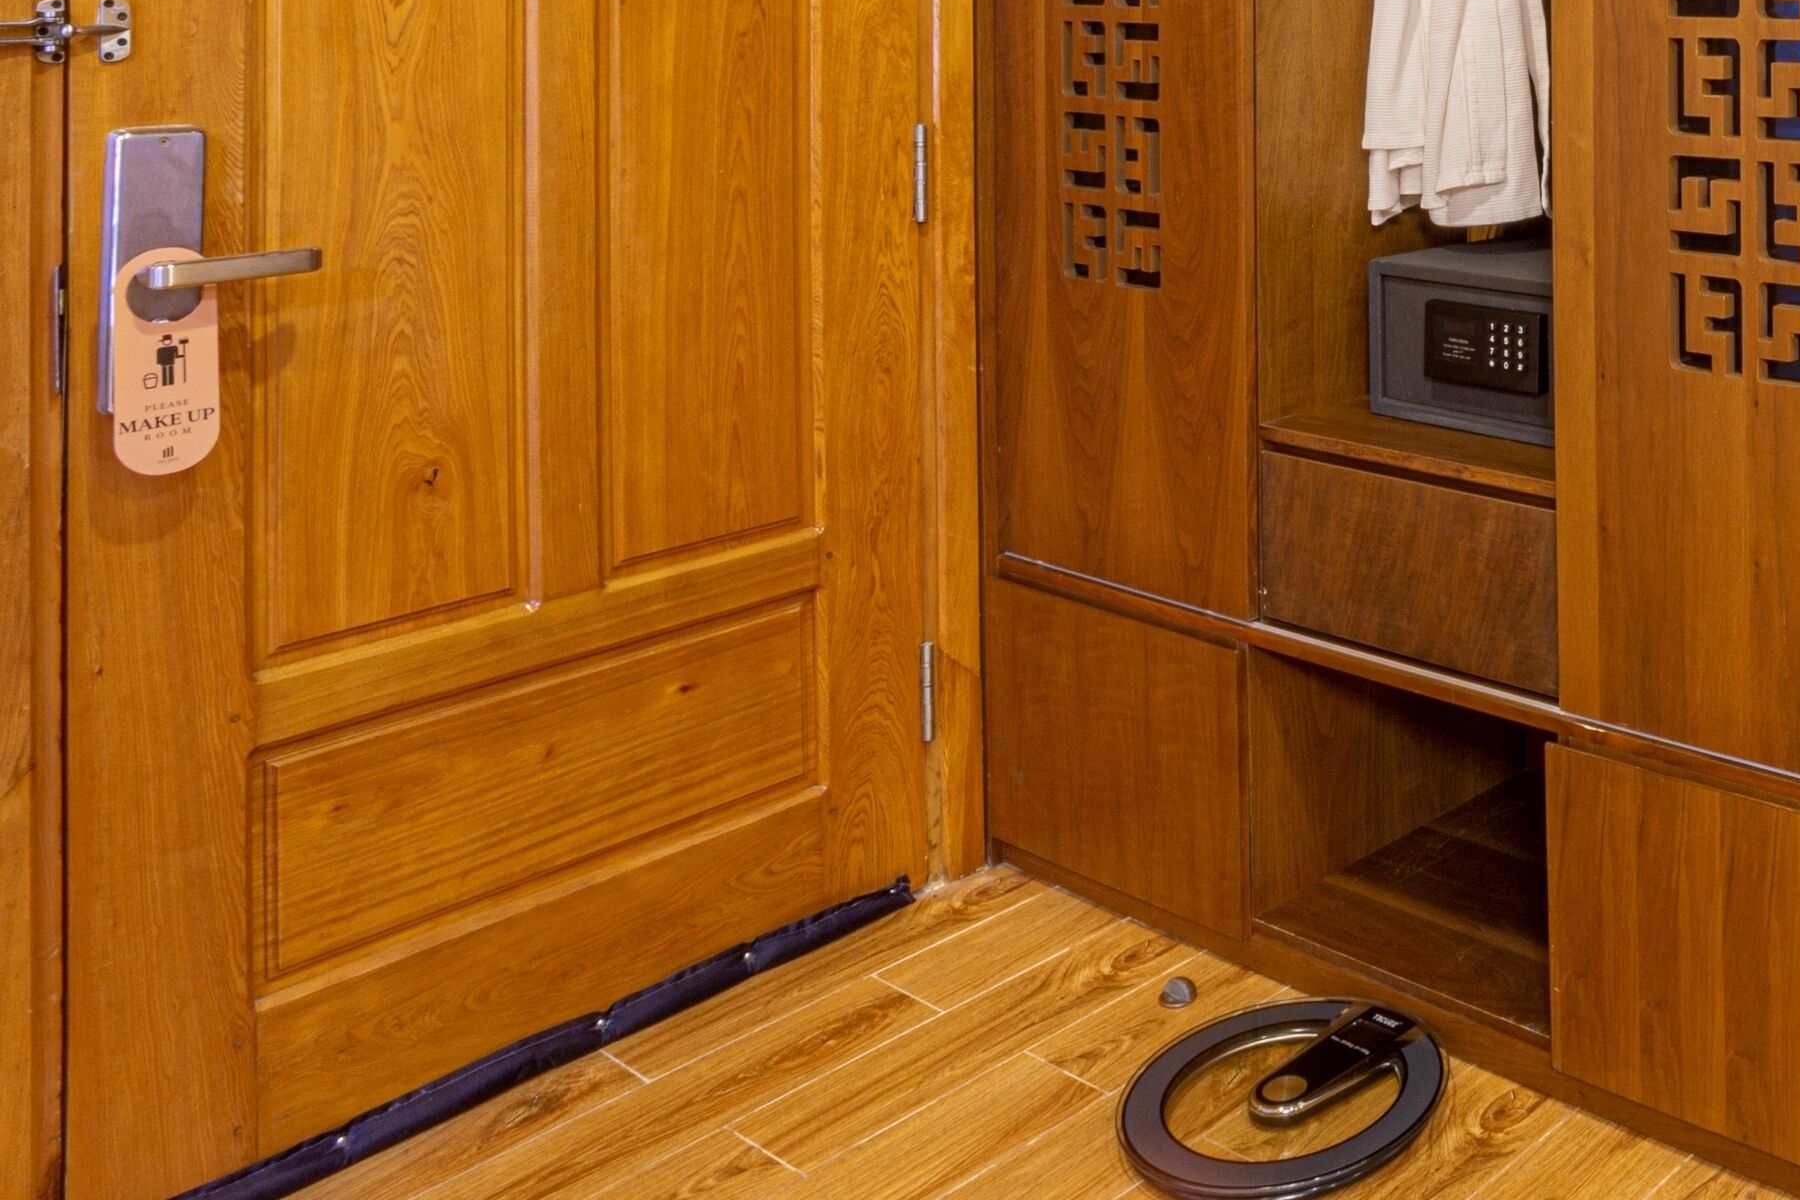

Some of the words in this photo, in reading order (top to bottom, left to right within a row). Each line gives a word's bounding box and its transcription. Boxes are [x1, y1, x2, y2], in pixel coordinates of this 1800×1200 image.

[1489, 322, 1495, 331] 1
[1503, 324, 1509, 333] 2
[1518, 326, 1523, 334] 3
[1489, 335, 1495, 343] 4
[1503, 336, 1509, 345] 5
[1517, 338, 1523, 347] 6
[1489, 347, 1495, 355] 7
[1503, 349, 1509, 358] 8
[1517, 351, 1523, 360] 9
[1503, 361, 1509, 370] 0
[144, 398, 190, 412] PLEASE
[118, 412, 183, 435] MAKE
[187, 407, 215, 423] UP
[144, 427, 192, 441] ROOM
